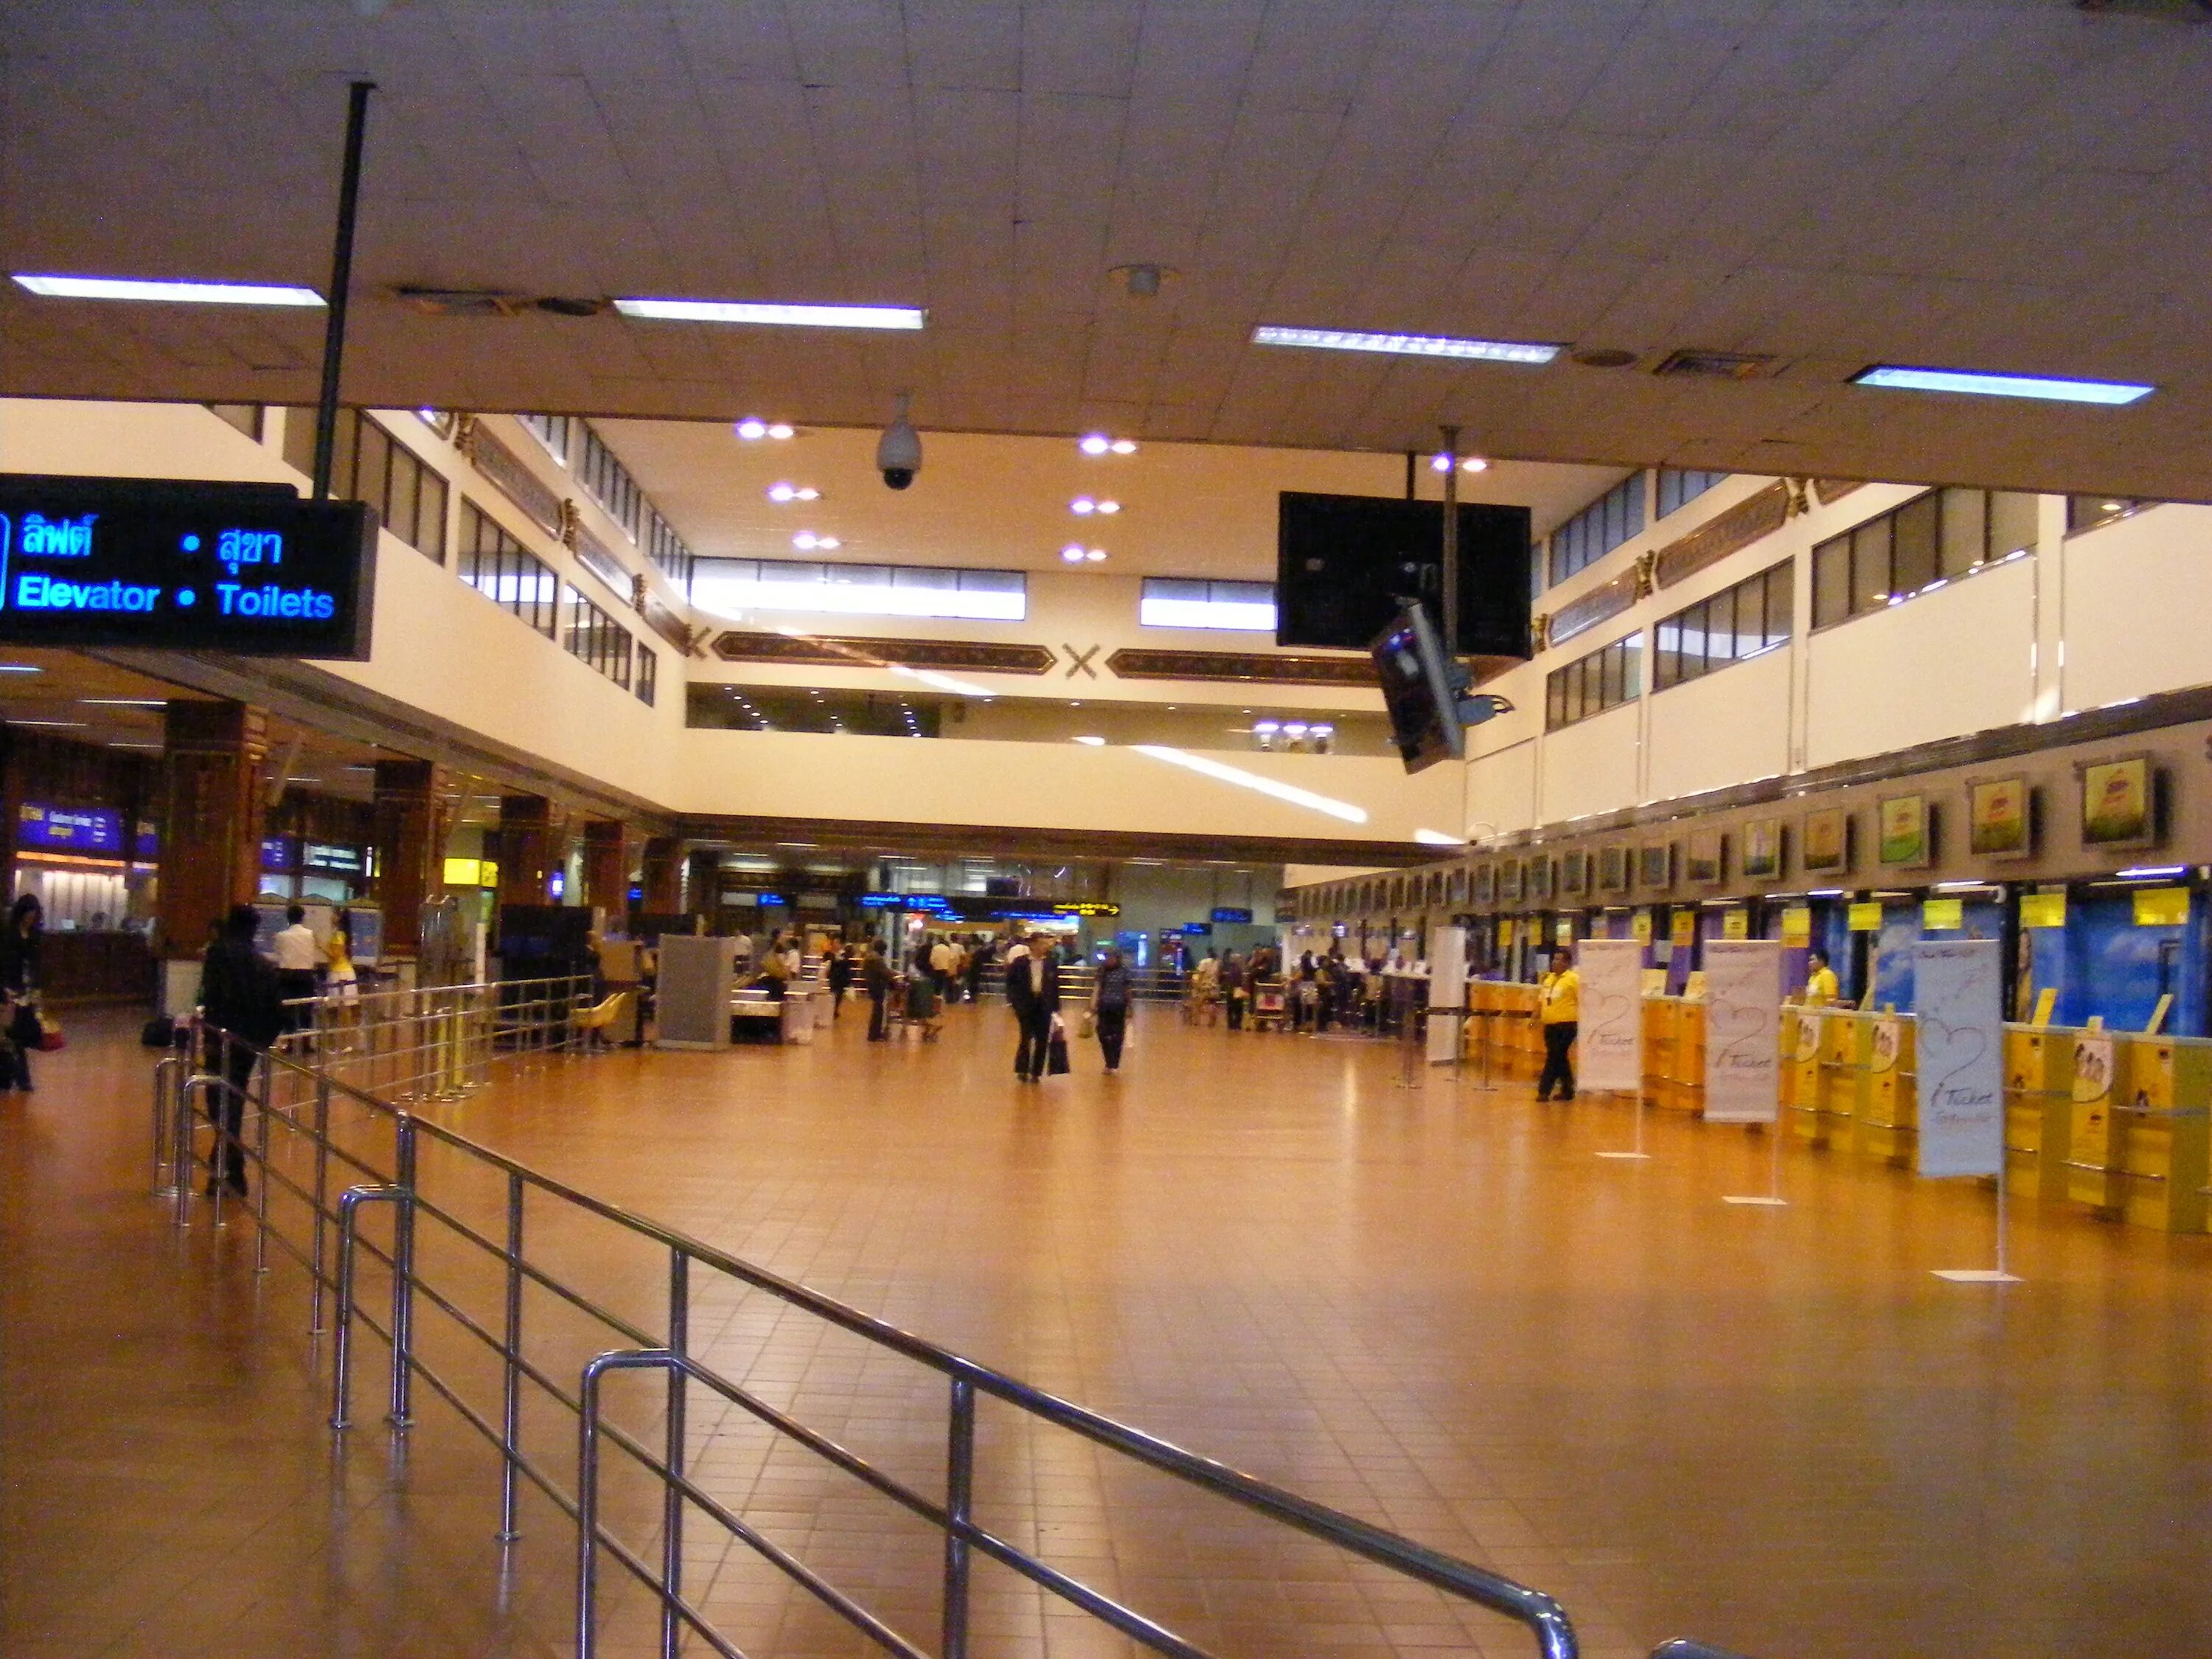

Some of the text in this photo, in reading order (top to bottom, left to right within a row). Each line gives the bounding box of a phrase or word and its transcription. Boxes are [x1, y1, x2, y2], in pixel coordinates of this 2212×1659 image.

[22, 514, 98, 557] ลิฟต์
[219, 529, 282, 575] สุขา
[17, 574, 161, 612] Elevator
[216, 583, 335, 619] Toilets
[1945, 1087, 1994, 1106] Ticket
